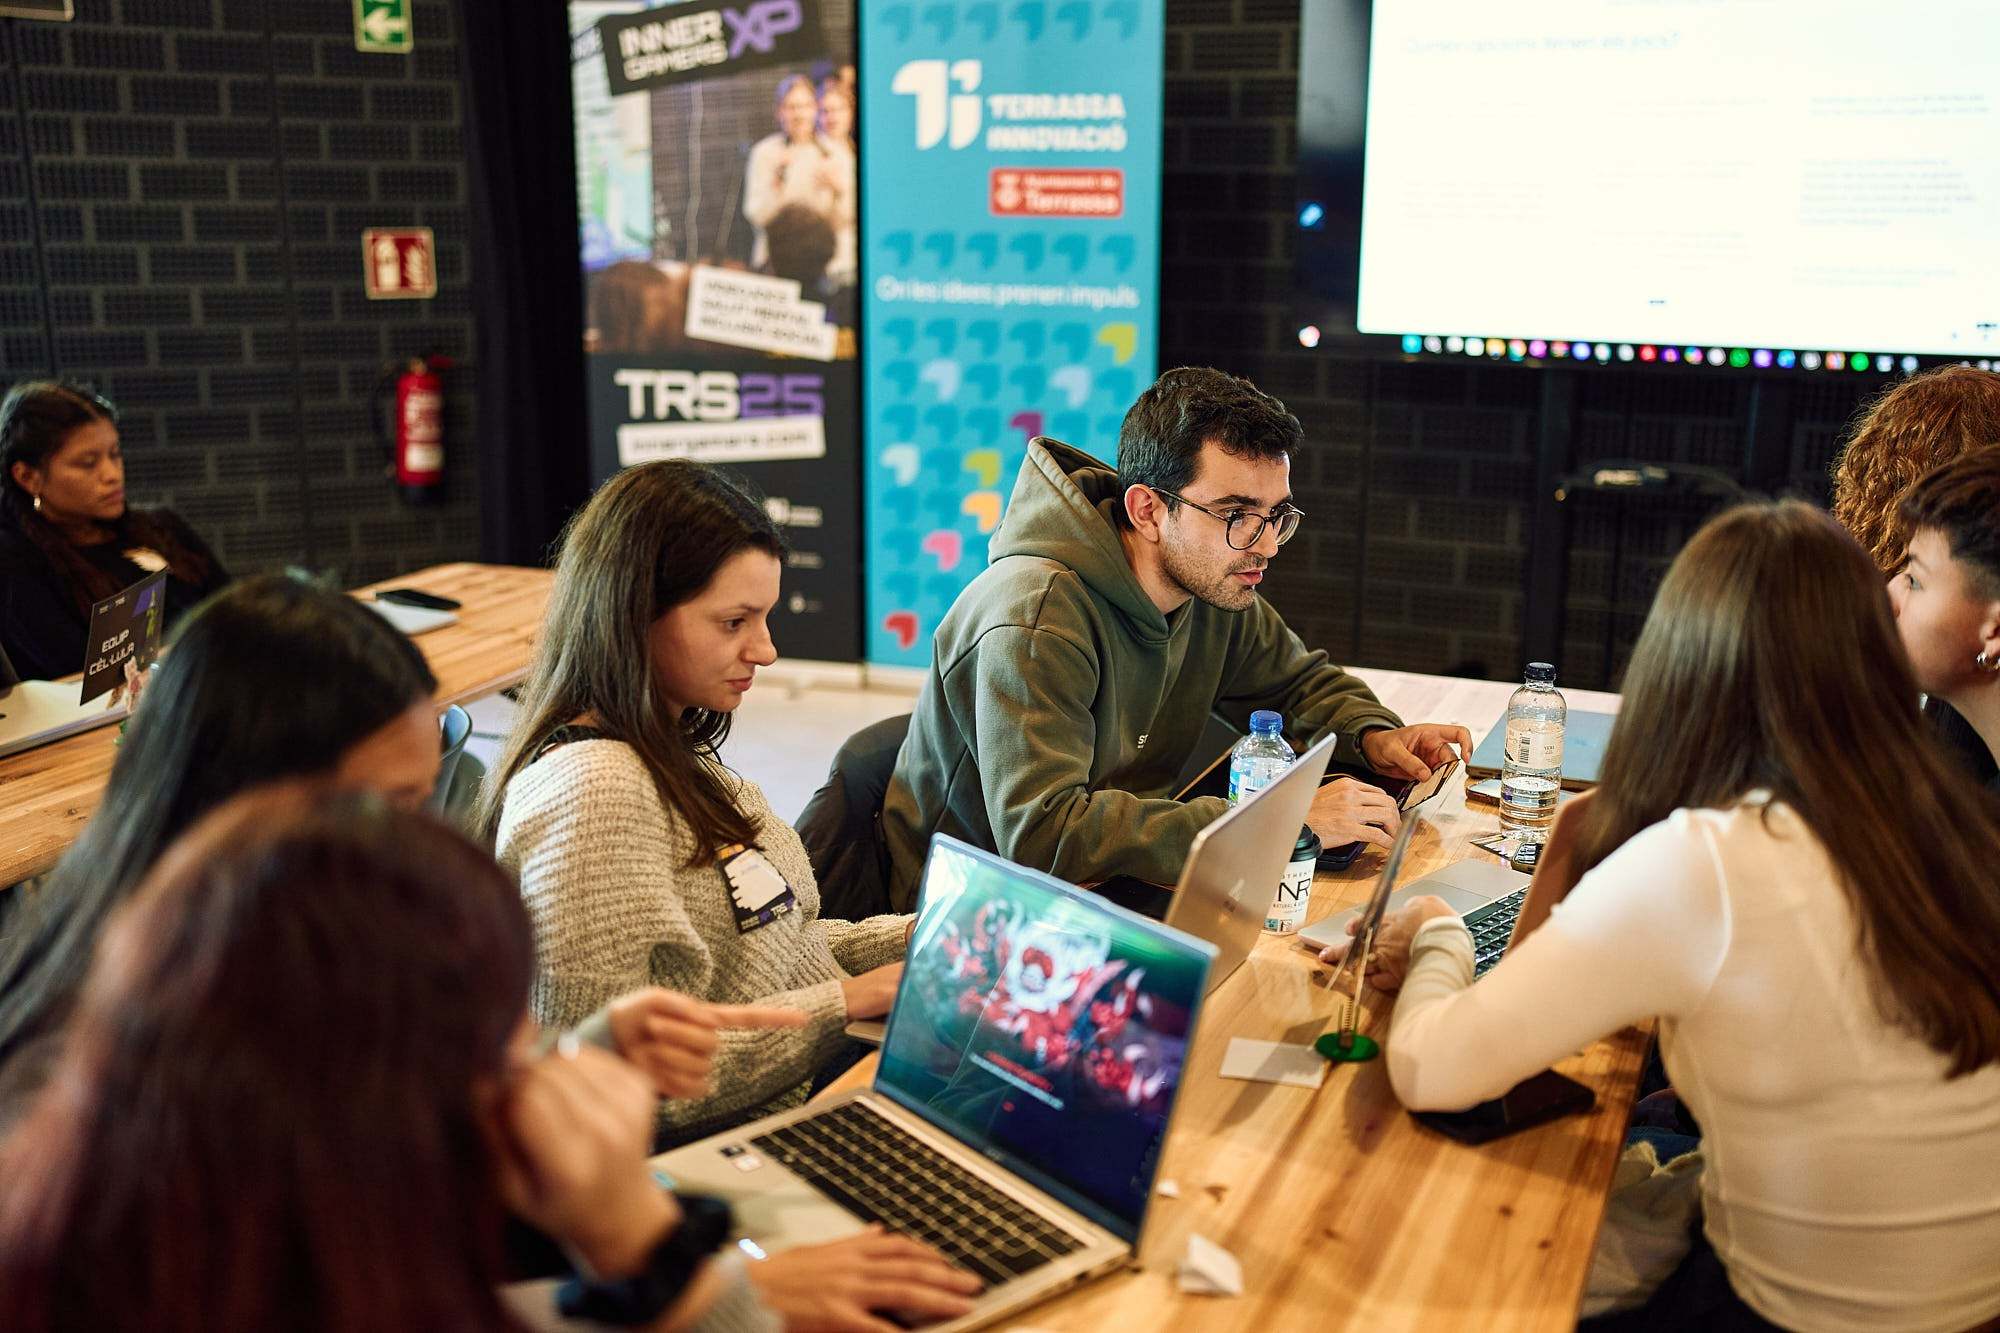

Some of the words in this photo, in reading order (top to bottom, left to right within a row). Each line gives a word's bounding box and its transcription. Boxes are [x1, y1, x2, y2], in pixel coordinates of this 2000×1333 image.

[618, 10, 724, 59] INNER
[723, 0, 803, 58] XP
[987, 93, 1127, 120] TERRASSA
[985, 121, 1128, 151] INNOVACIÓ
